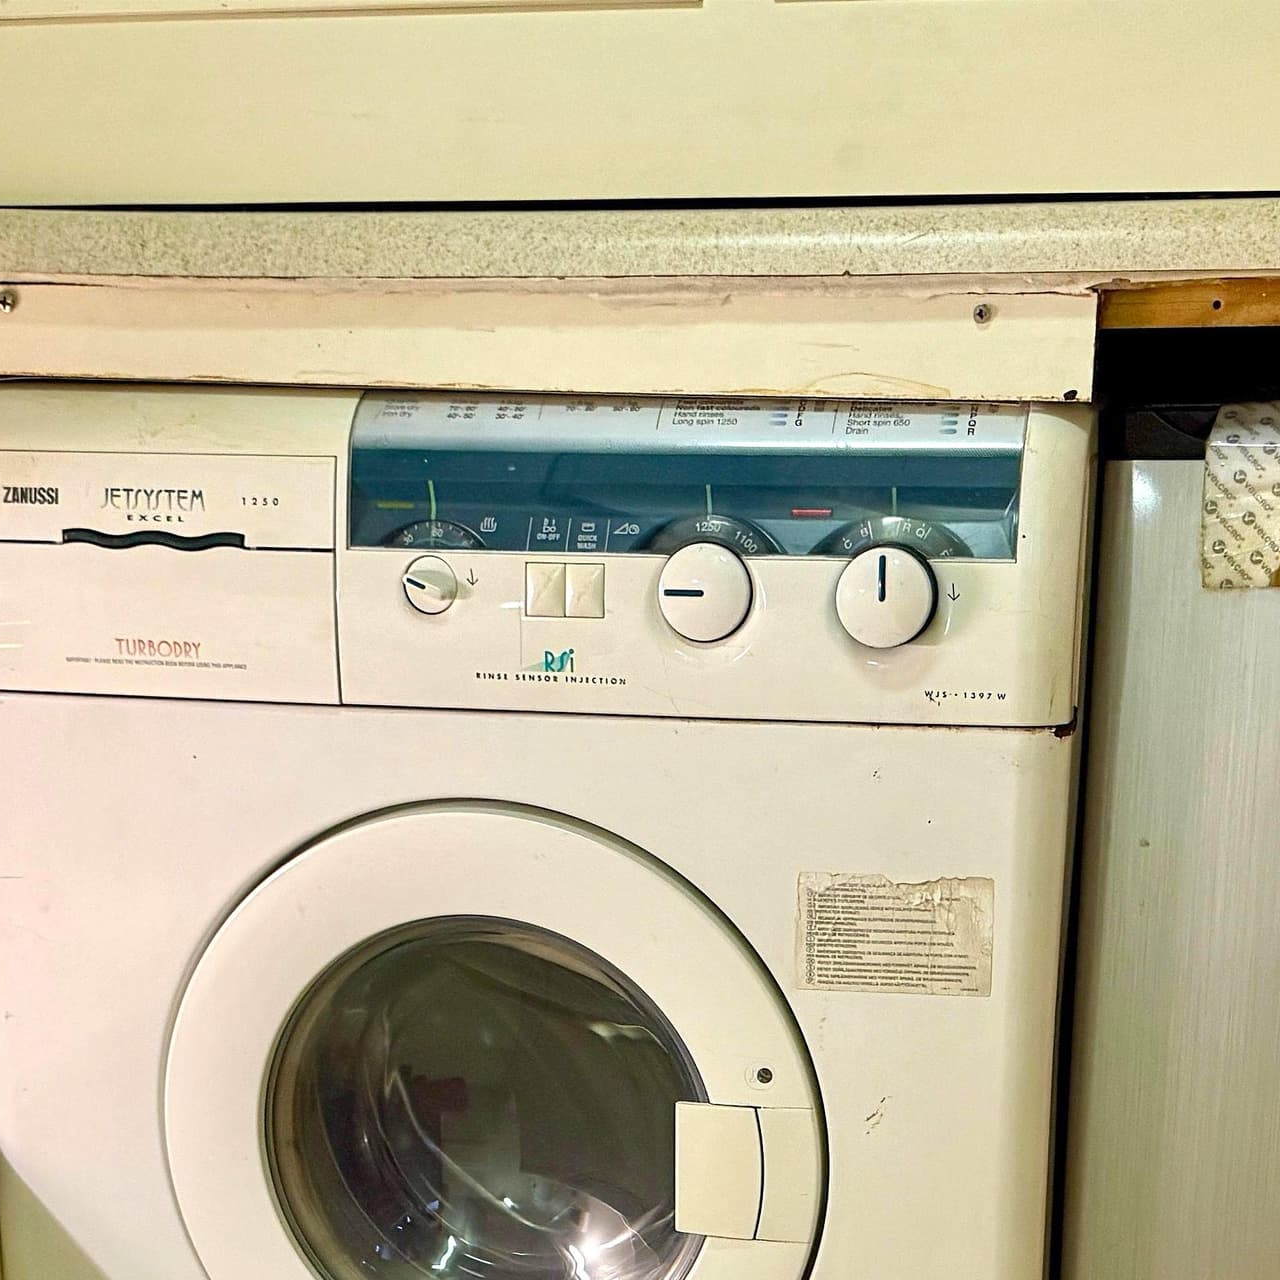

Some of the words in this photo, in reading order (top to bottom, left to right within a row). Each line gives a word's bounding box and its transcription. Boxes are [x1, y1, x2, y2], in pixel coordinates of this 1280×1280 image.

[672, 418, 694, 426] Long
[696, 418, 714, 426] spin
[717, 418, 738, 426] 1250
[847, 419, 871, 427] Short
[873, 419, 892, 428] spin
[845, 427, 869, 435] Drain
[967, 427, 975, 436] R
[2, 486, 59, 505] ZANUSSI
[100, 487, 206, 512] JETSYSTEM
[240, 497, 280, 507] 1250
[126, 514, 185, 523] EXCEL
[695, 521, 721, 532] 1250
[577, 534, 598, 542] QUICK
[735, 531, 758, 553] 1100
[114, 637, 201, 659] TURBODRY
[475, 672, 509, 681] RINSE
[514, 673, 559, 683] SENSOR
[565, 675, 628, 686] INJECTION
